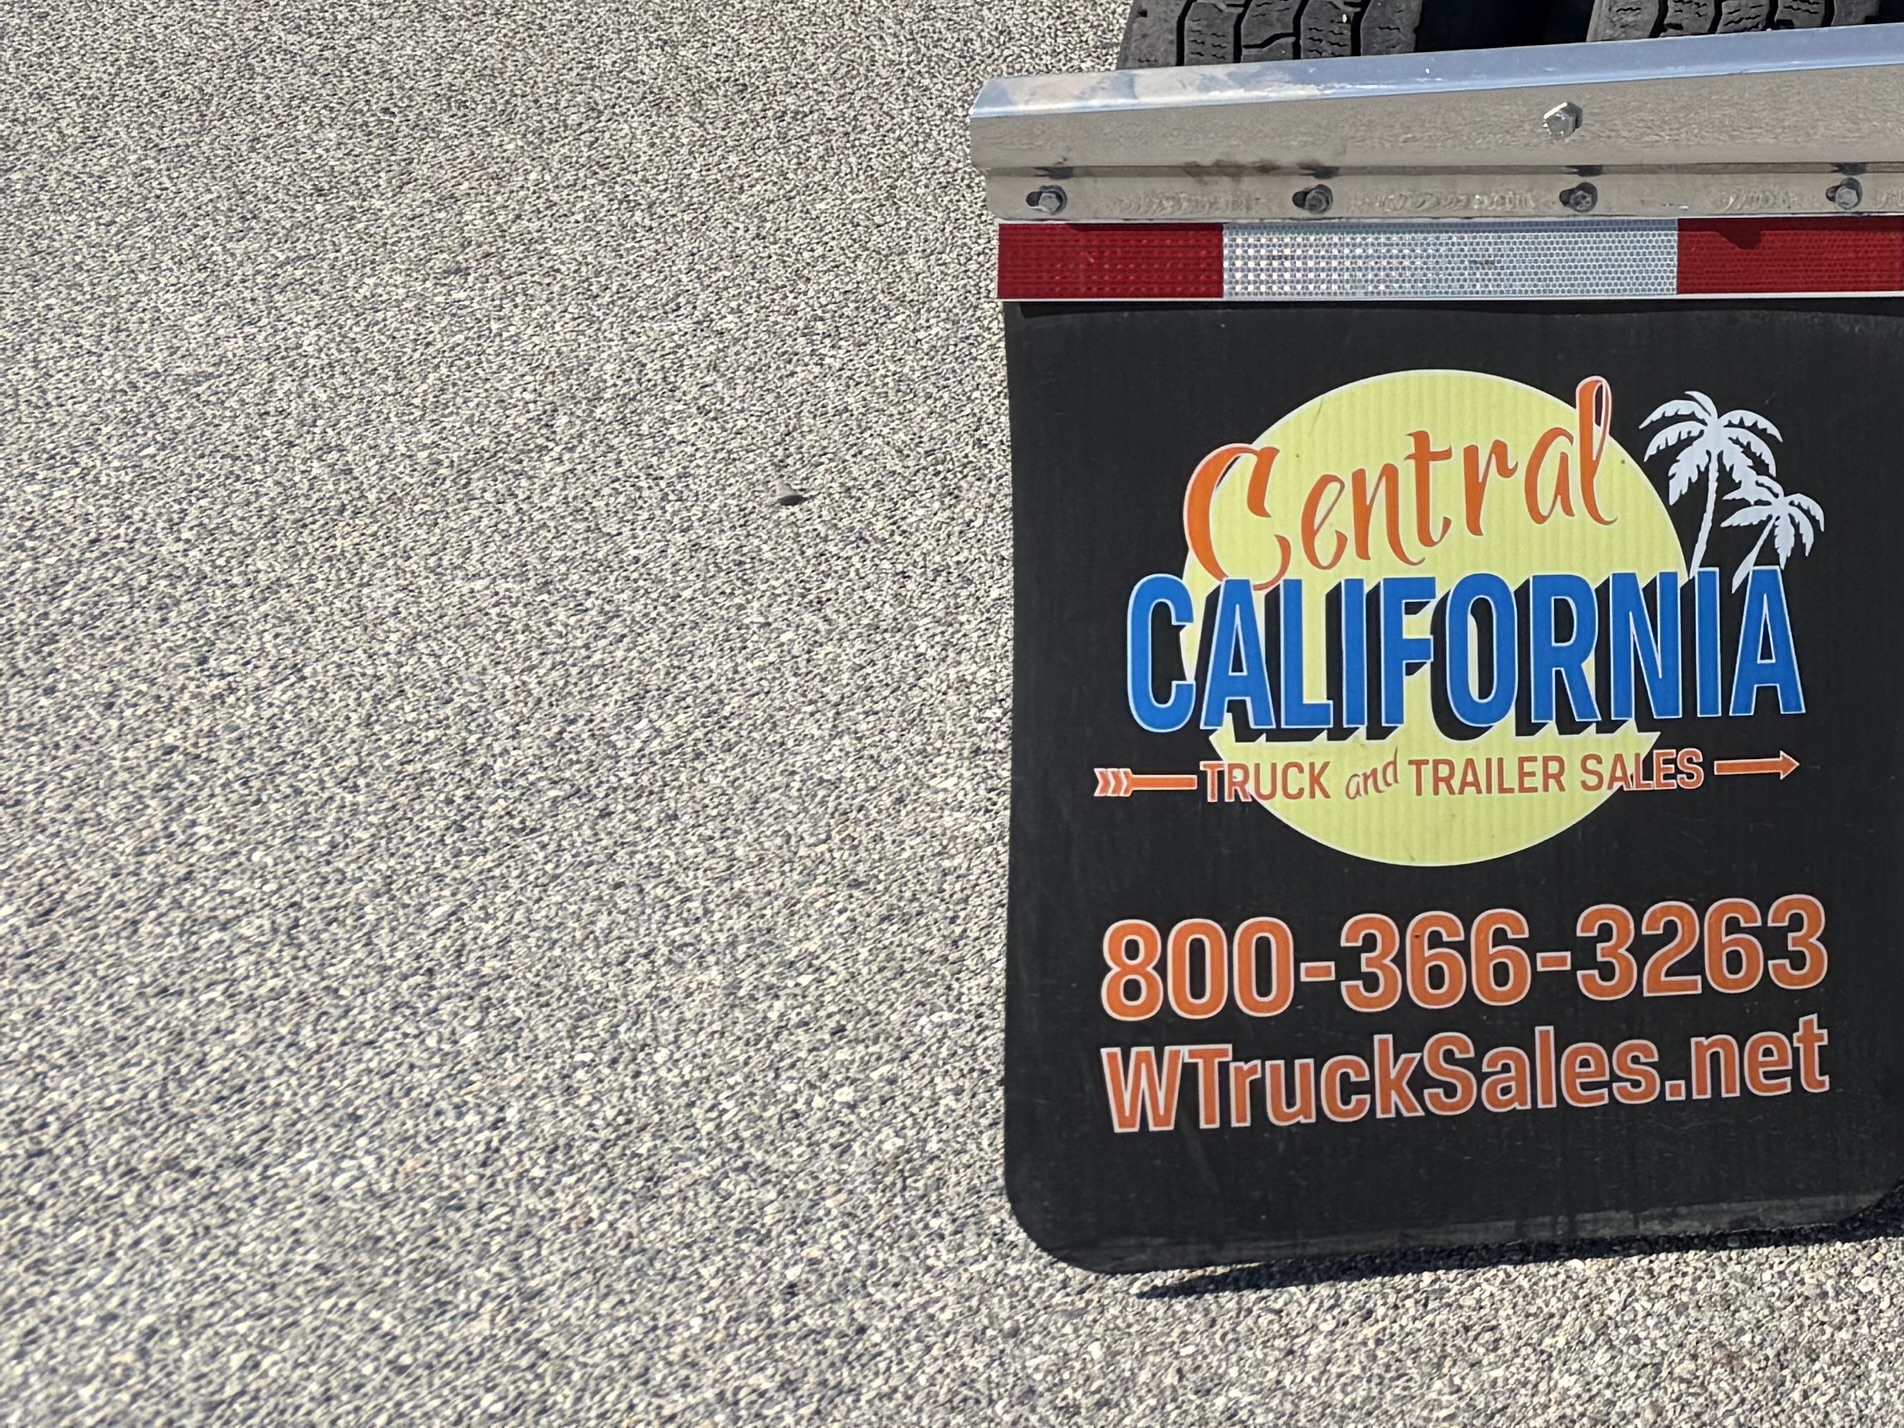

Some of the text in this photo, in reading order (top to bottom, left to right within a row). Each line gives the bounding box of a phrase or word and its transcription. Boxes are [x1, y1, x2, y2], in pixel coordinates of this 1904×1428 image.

[1184, 376, 1618, 591] Central
[1127, 567, 1806, 733] CALIFORNIA
[1200, 748, 1704, 802] TRUCK and TRAILER SALES
[1100, 895, 1829, 1020] 800-366-3263
[1101, 1014, 1831, 1132] WTruckSales.net
